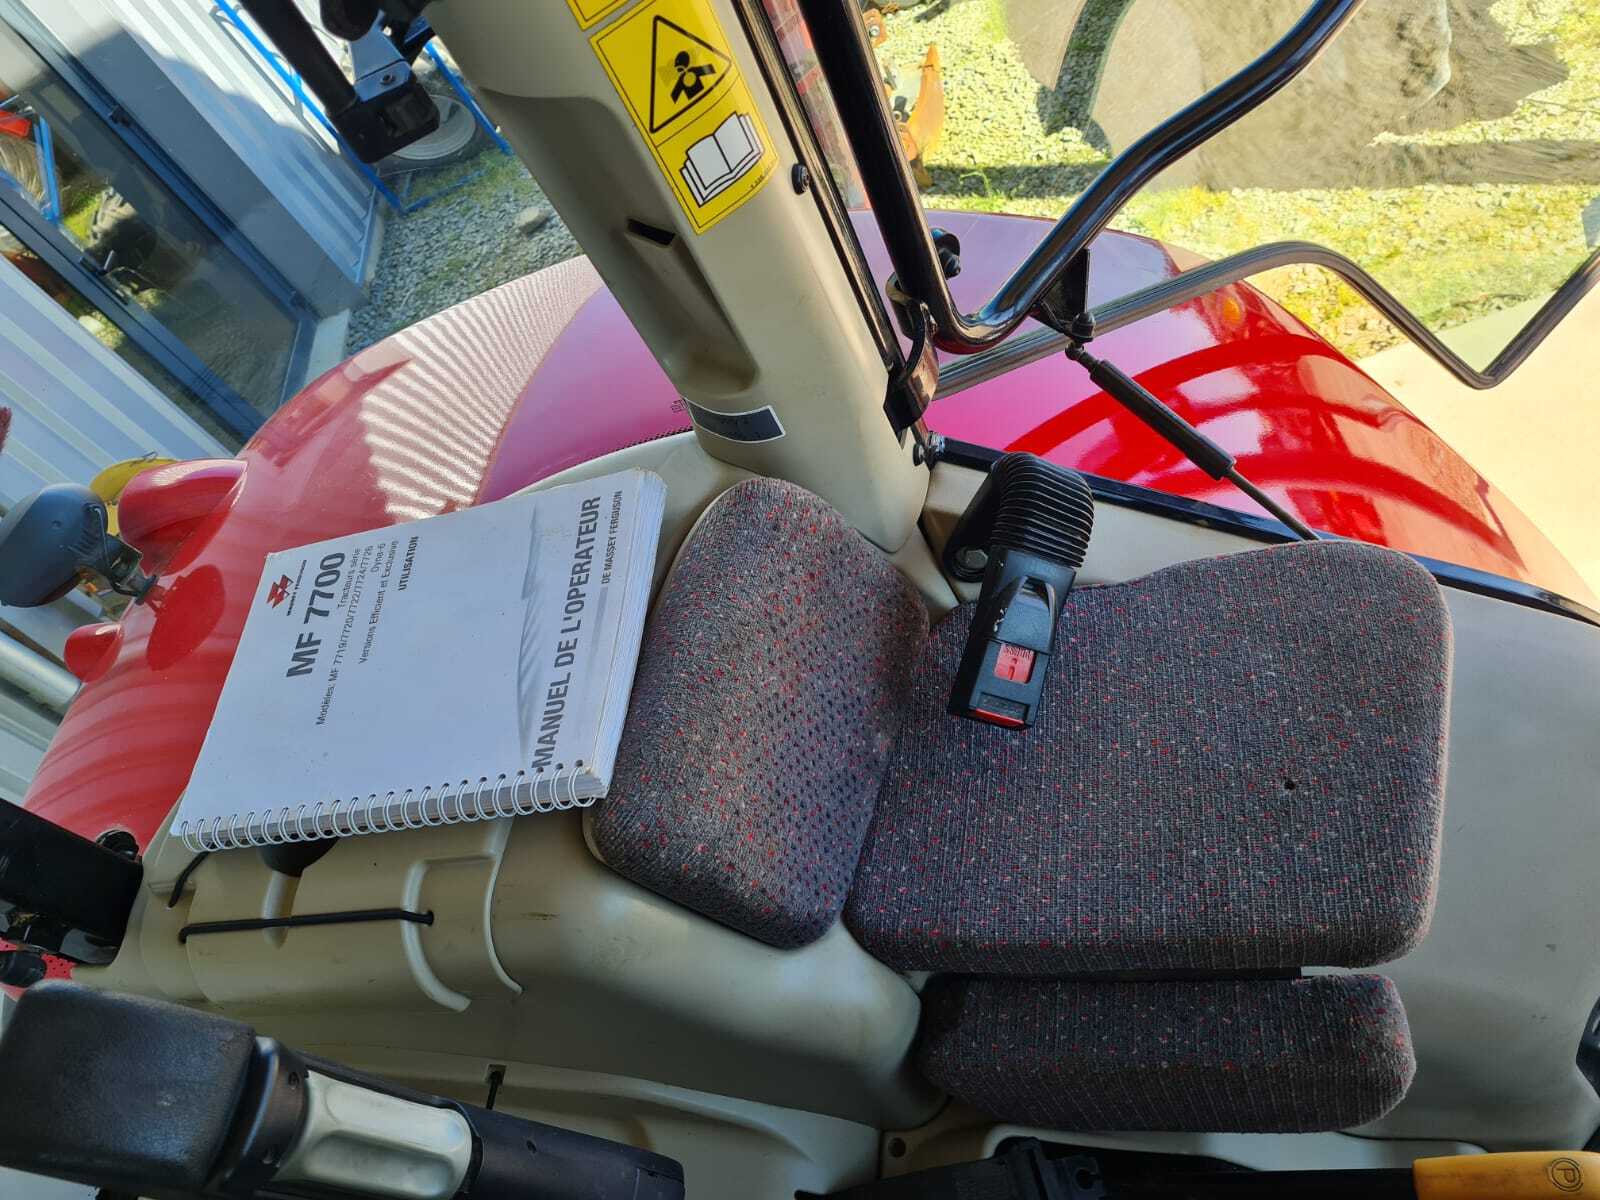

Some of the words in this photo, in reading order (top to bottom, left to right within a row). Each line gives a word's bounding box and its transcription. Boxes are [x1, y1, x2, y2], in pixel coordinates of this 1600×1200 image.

[609, 490, 623, 535] FERGUSON
[398, 535, 419, 591] UTILISATION
[560, 495, 602, 634] L'OPERATEUR
[603, 536, 617, 571] MASSEY
[303, 552, 346, 625] 7700
[601, 571, 612, 585] DE
[286, 631, 322, 677] MF
[358, 626, 377, 665] Versions
[554, 637, 578, 668] DE
[328, 667, 339, 682] MF
[531, 671, 572, 769] MANUEL
